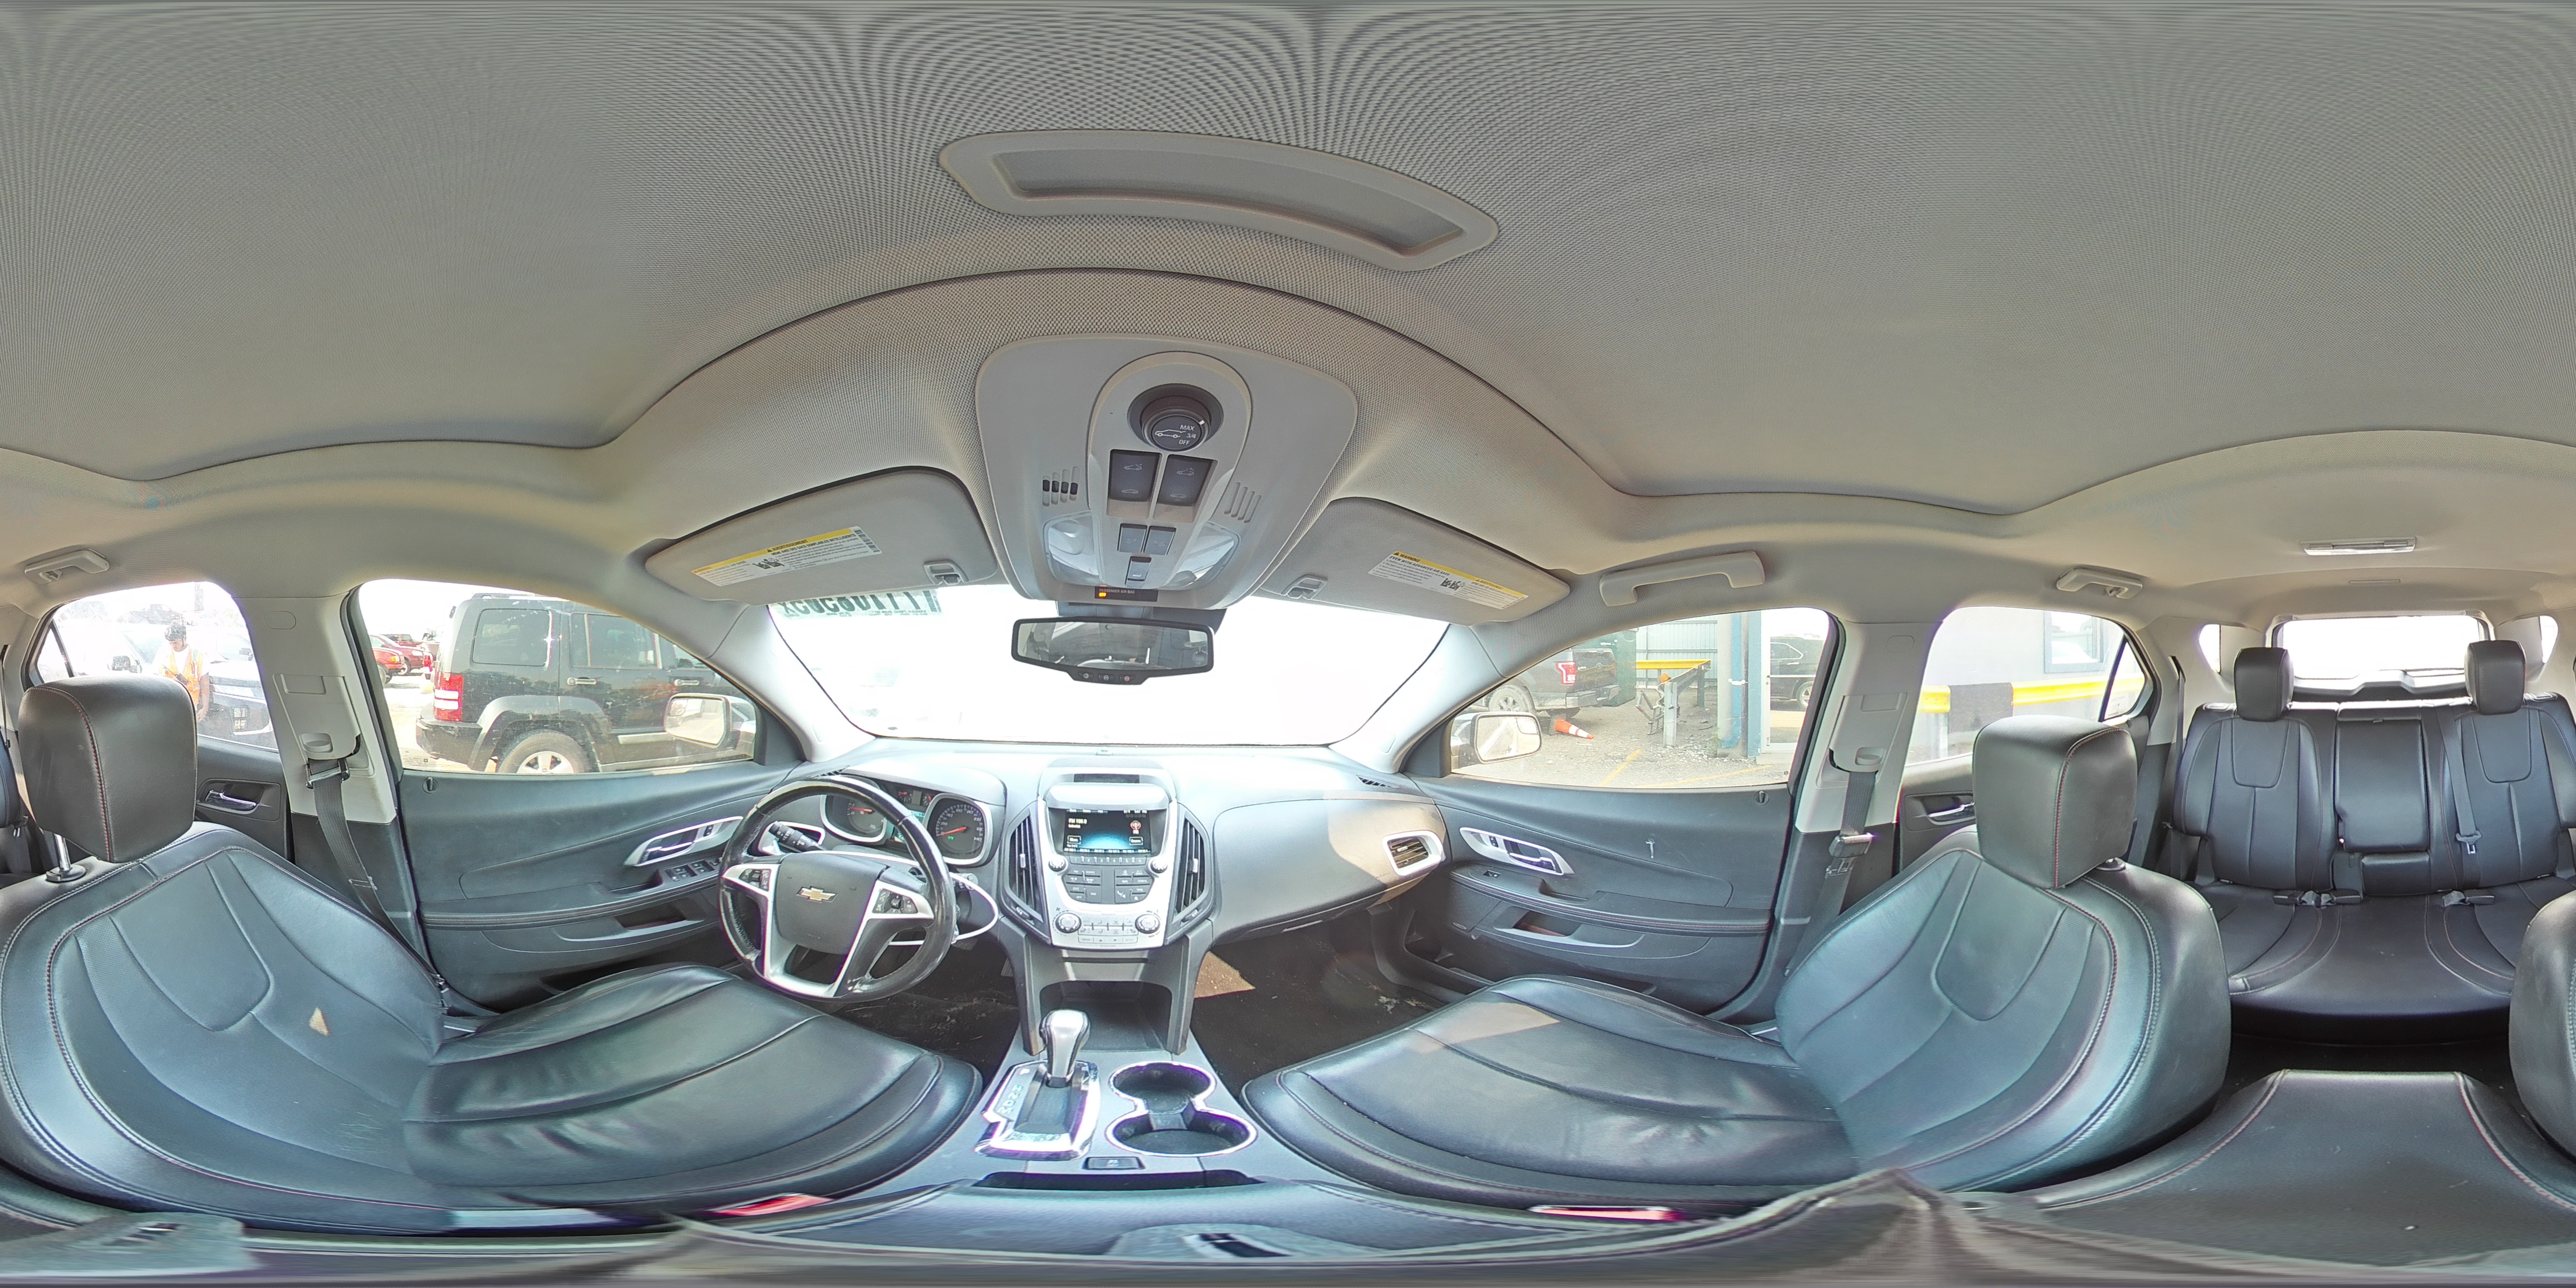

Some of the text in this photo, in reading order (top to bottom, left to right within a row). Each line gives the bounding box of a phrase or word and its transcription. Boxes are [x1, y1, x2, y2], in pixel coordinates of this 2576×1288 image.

[772, 540, 808, 551] AVERTISSEMENT
[1400, 553, 1421, 562] WARNING
[1412, 563, 1433, 571] ADVANCED
